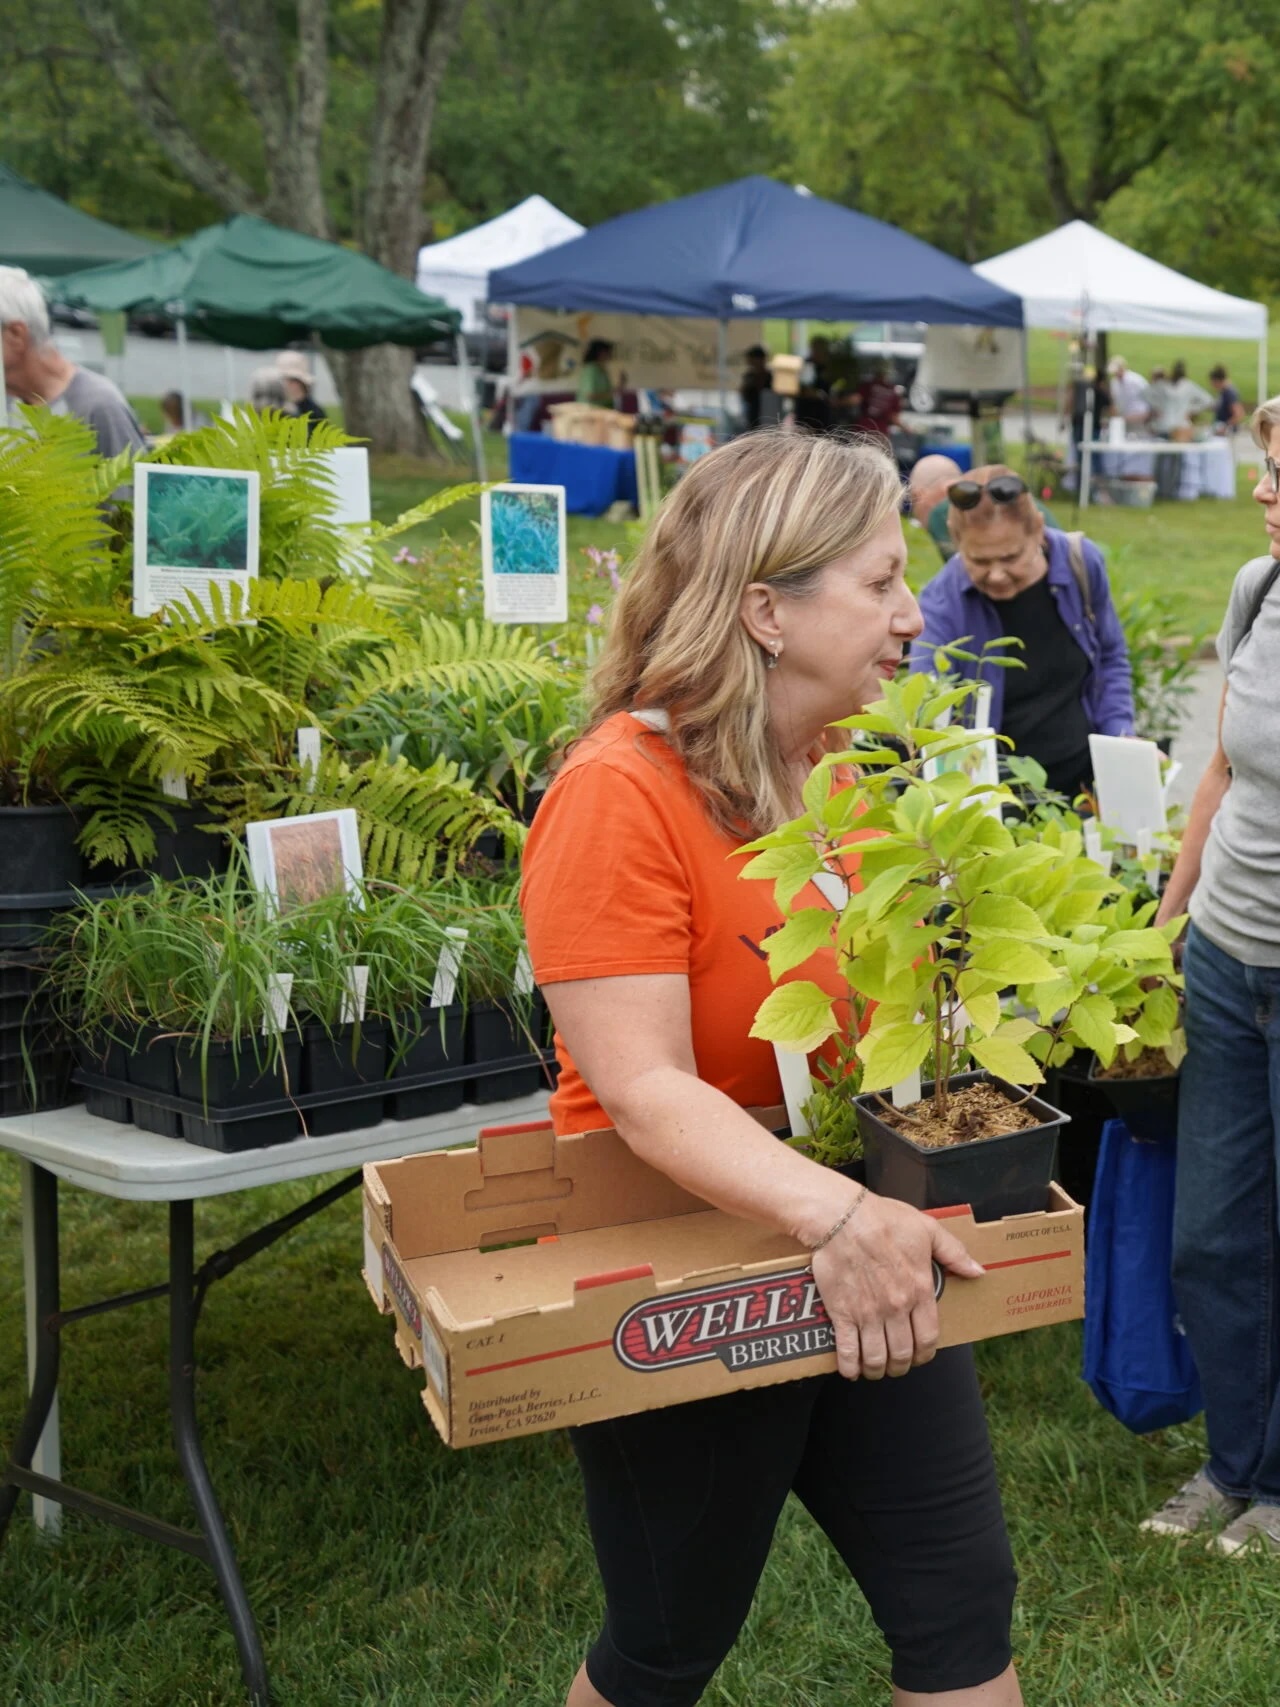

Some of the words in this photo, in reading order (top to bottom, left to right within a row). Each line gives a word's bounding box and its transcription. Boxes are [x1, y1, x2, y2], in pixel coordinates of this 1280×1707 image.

[1006, 1228, 1040, 1241] PRODUCT
[1041, 1226, 1051, 1235] OF
[1006, 1285, 1072, 1306] CALIFORNIA
[1006, 1297, 1073, 1316] STRAWBERRIES
[466, 1337, 494, 1350] CAT.
[469, 1389, 528, 1412] Distributed
[530, 1388, 541, 1400] by
[526, 1398, 567, 1413] Berries,
[469, 1424, 504, 1438] Irvine,
[506, 1418, 522, 1430] CA
[525, 1410, 556, 1425] 92620
